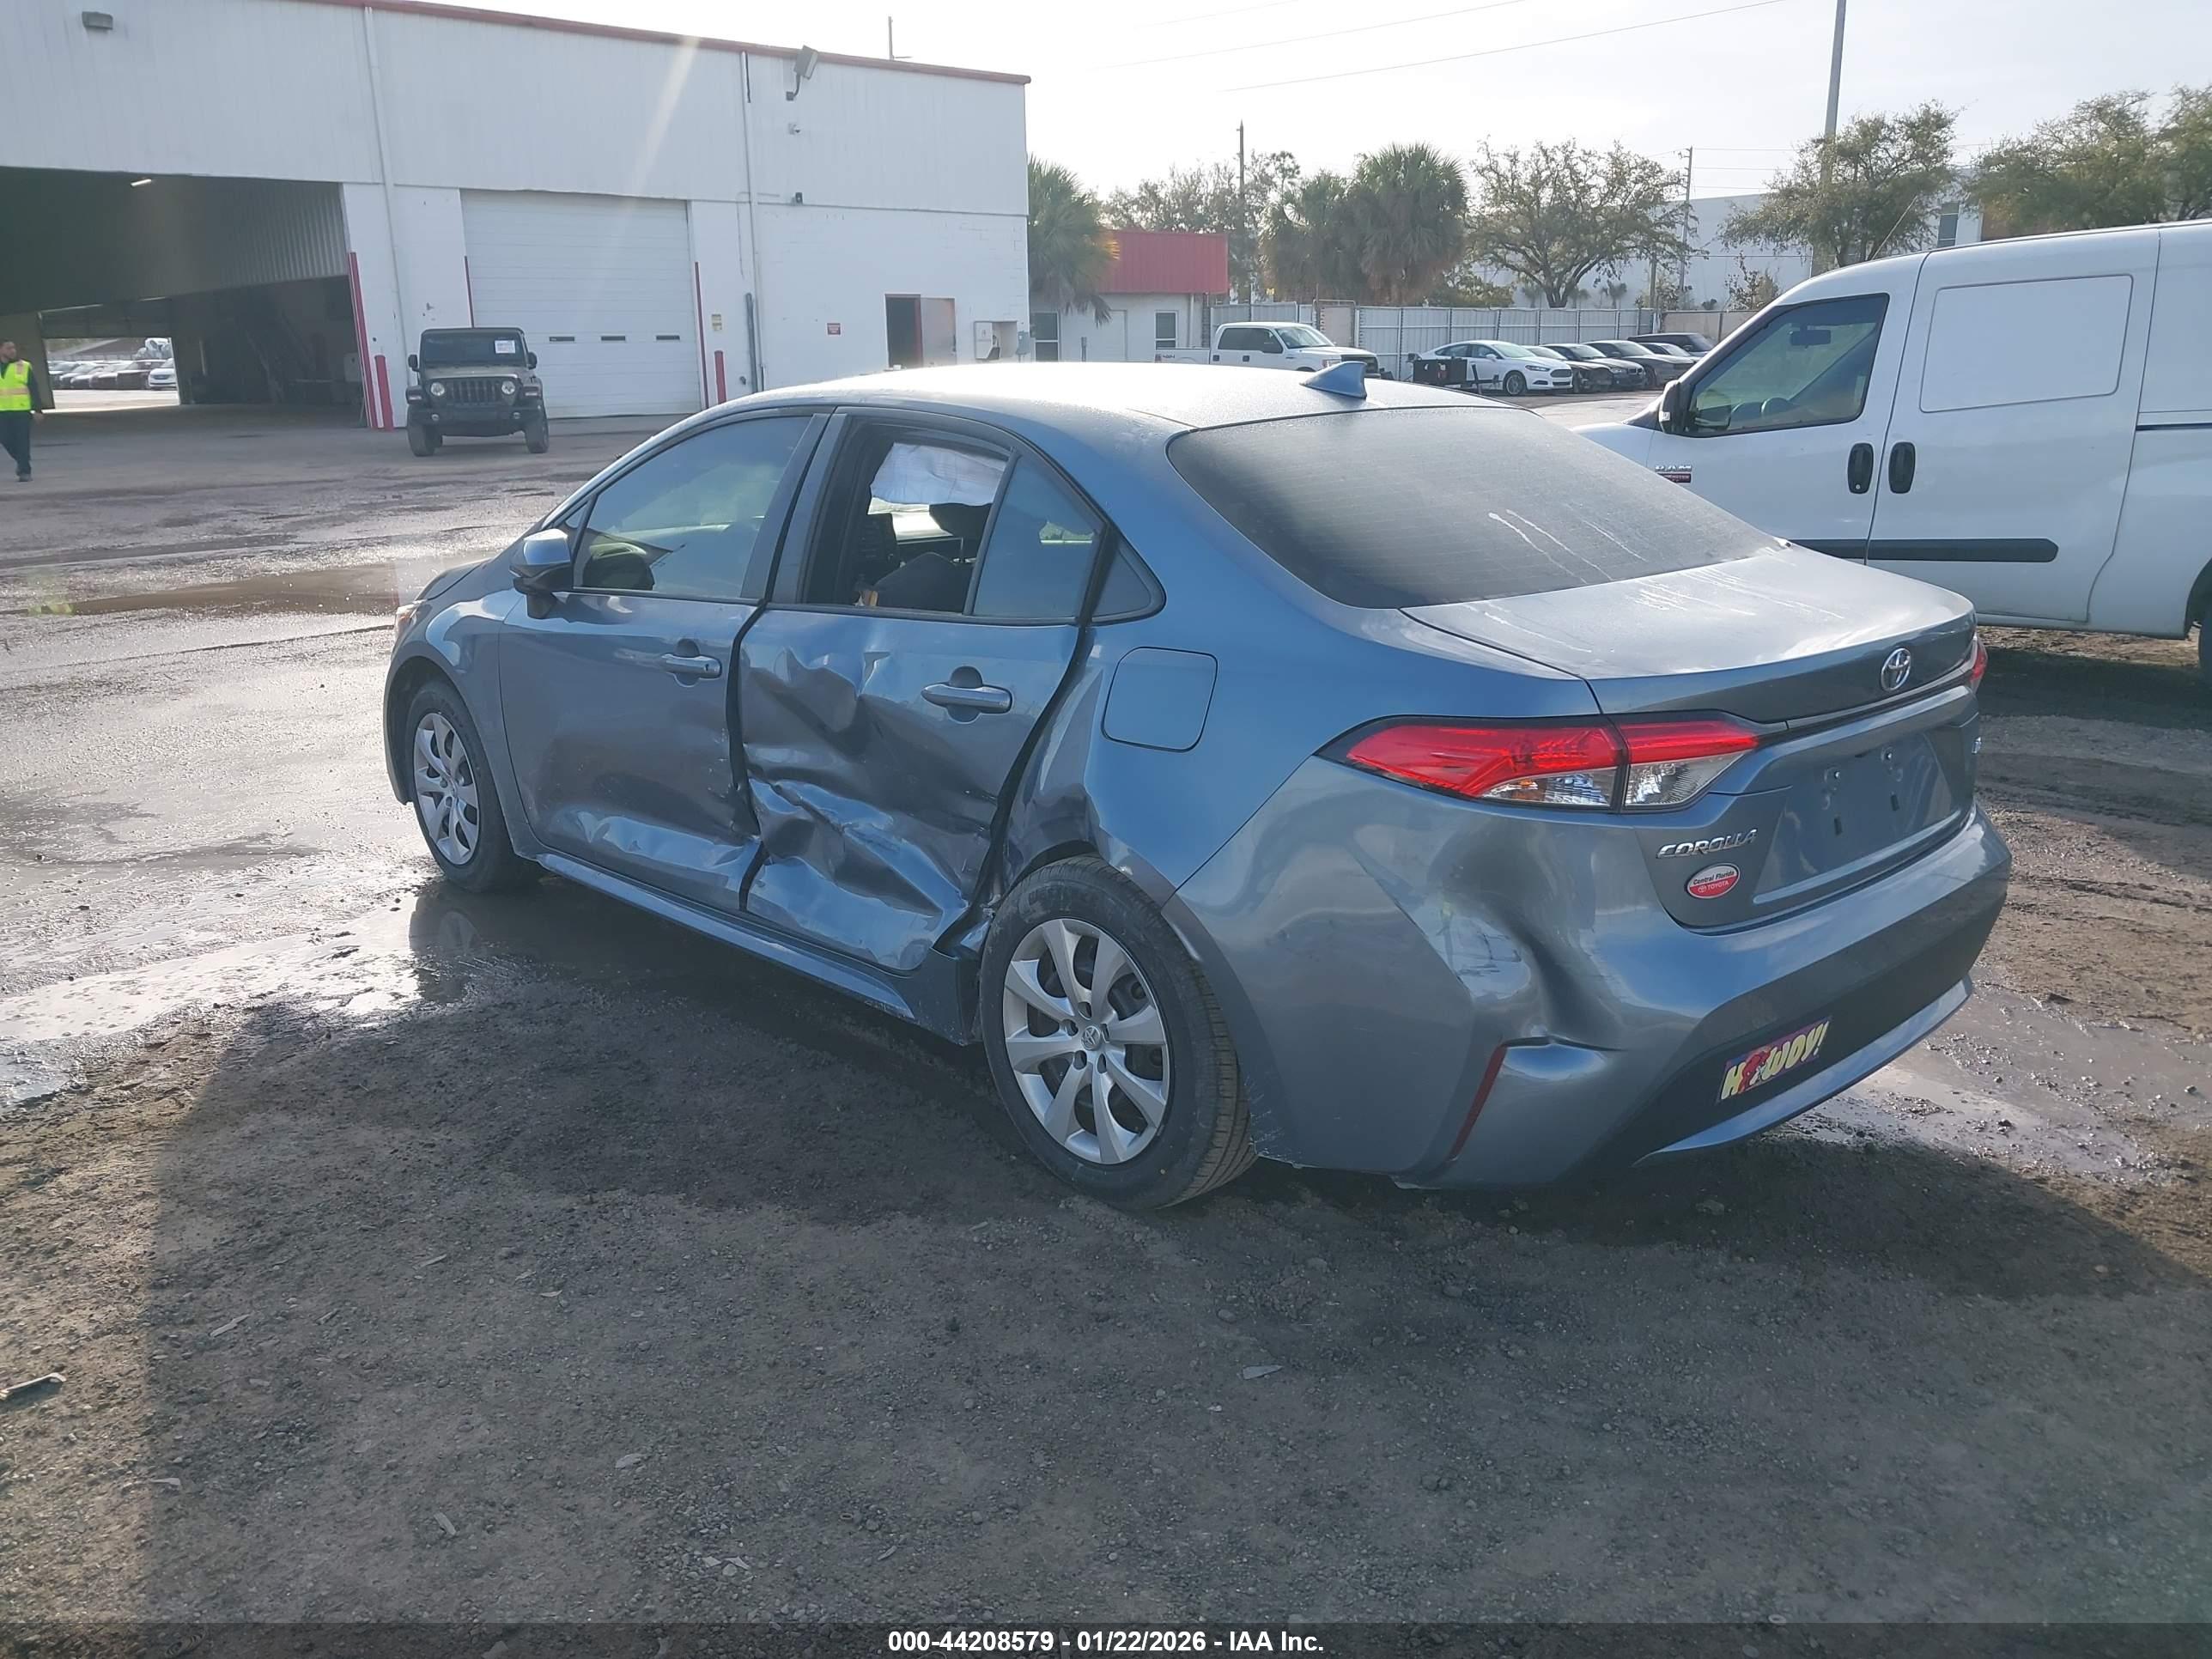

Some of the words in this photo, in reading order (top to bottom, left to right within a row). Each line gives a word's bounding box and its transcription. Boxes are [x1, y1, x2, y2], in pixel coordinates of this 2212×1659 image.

[1656, 829, 1757, 859] COROLLA
[1692, 874, 1715, 885] Central
[1715, 870, 1735, 880] Florida
[1707, 880, 1729, 890] TOYOTA
[1721, 1020, 1830, 1100] HWDY!
